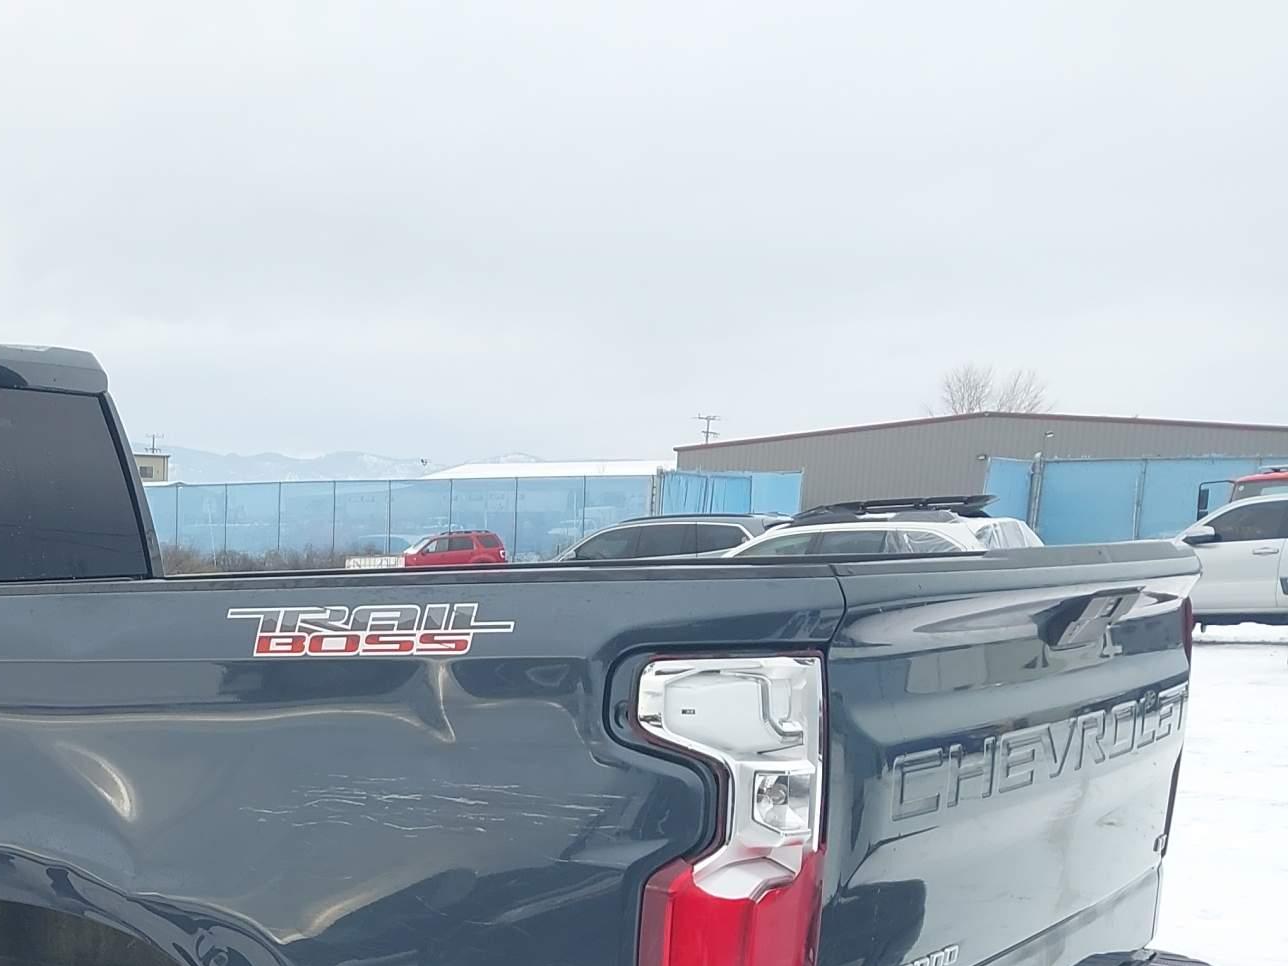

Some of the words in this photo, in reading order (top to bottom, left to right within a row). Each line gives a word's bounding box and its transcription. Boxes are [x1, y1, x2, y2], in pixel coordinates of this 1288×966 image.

[226, 603, 515, 634] TRAIL
[253, 631, 474, 657] BOSS
[891, 681, 1189, 822] CHEVROLET
